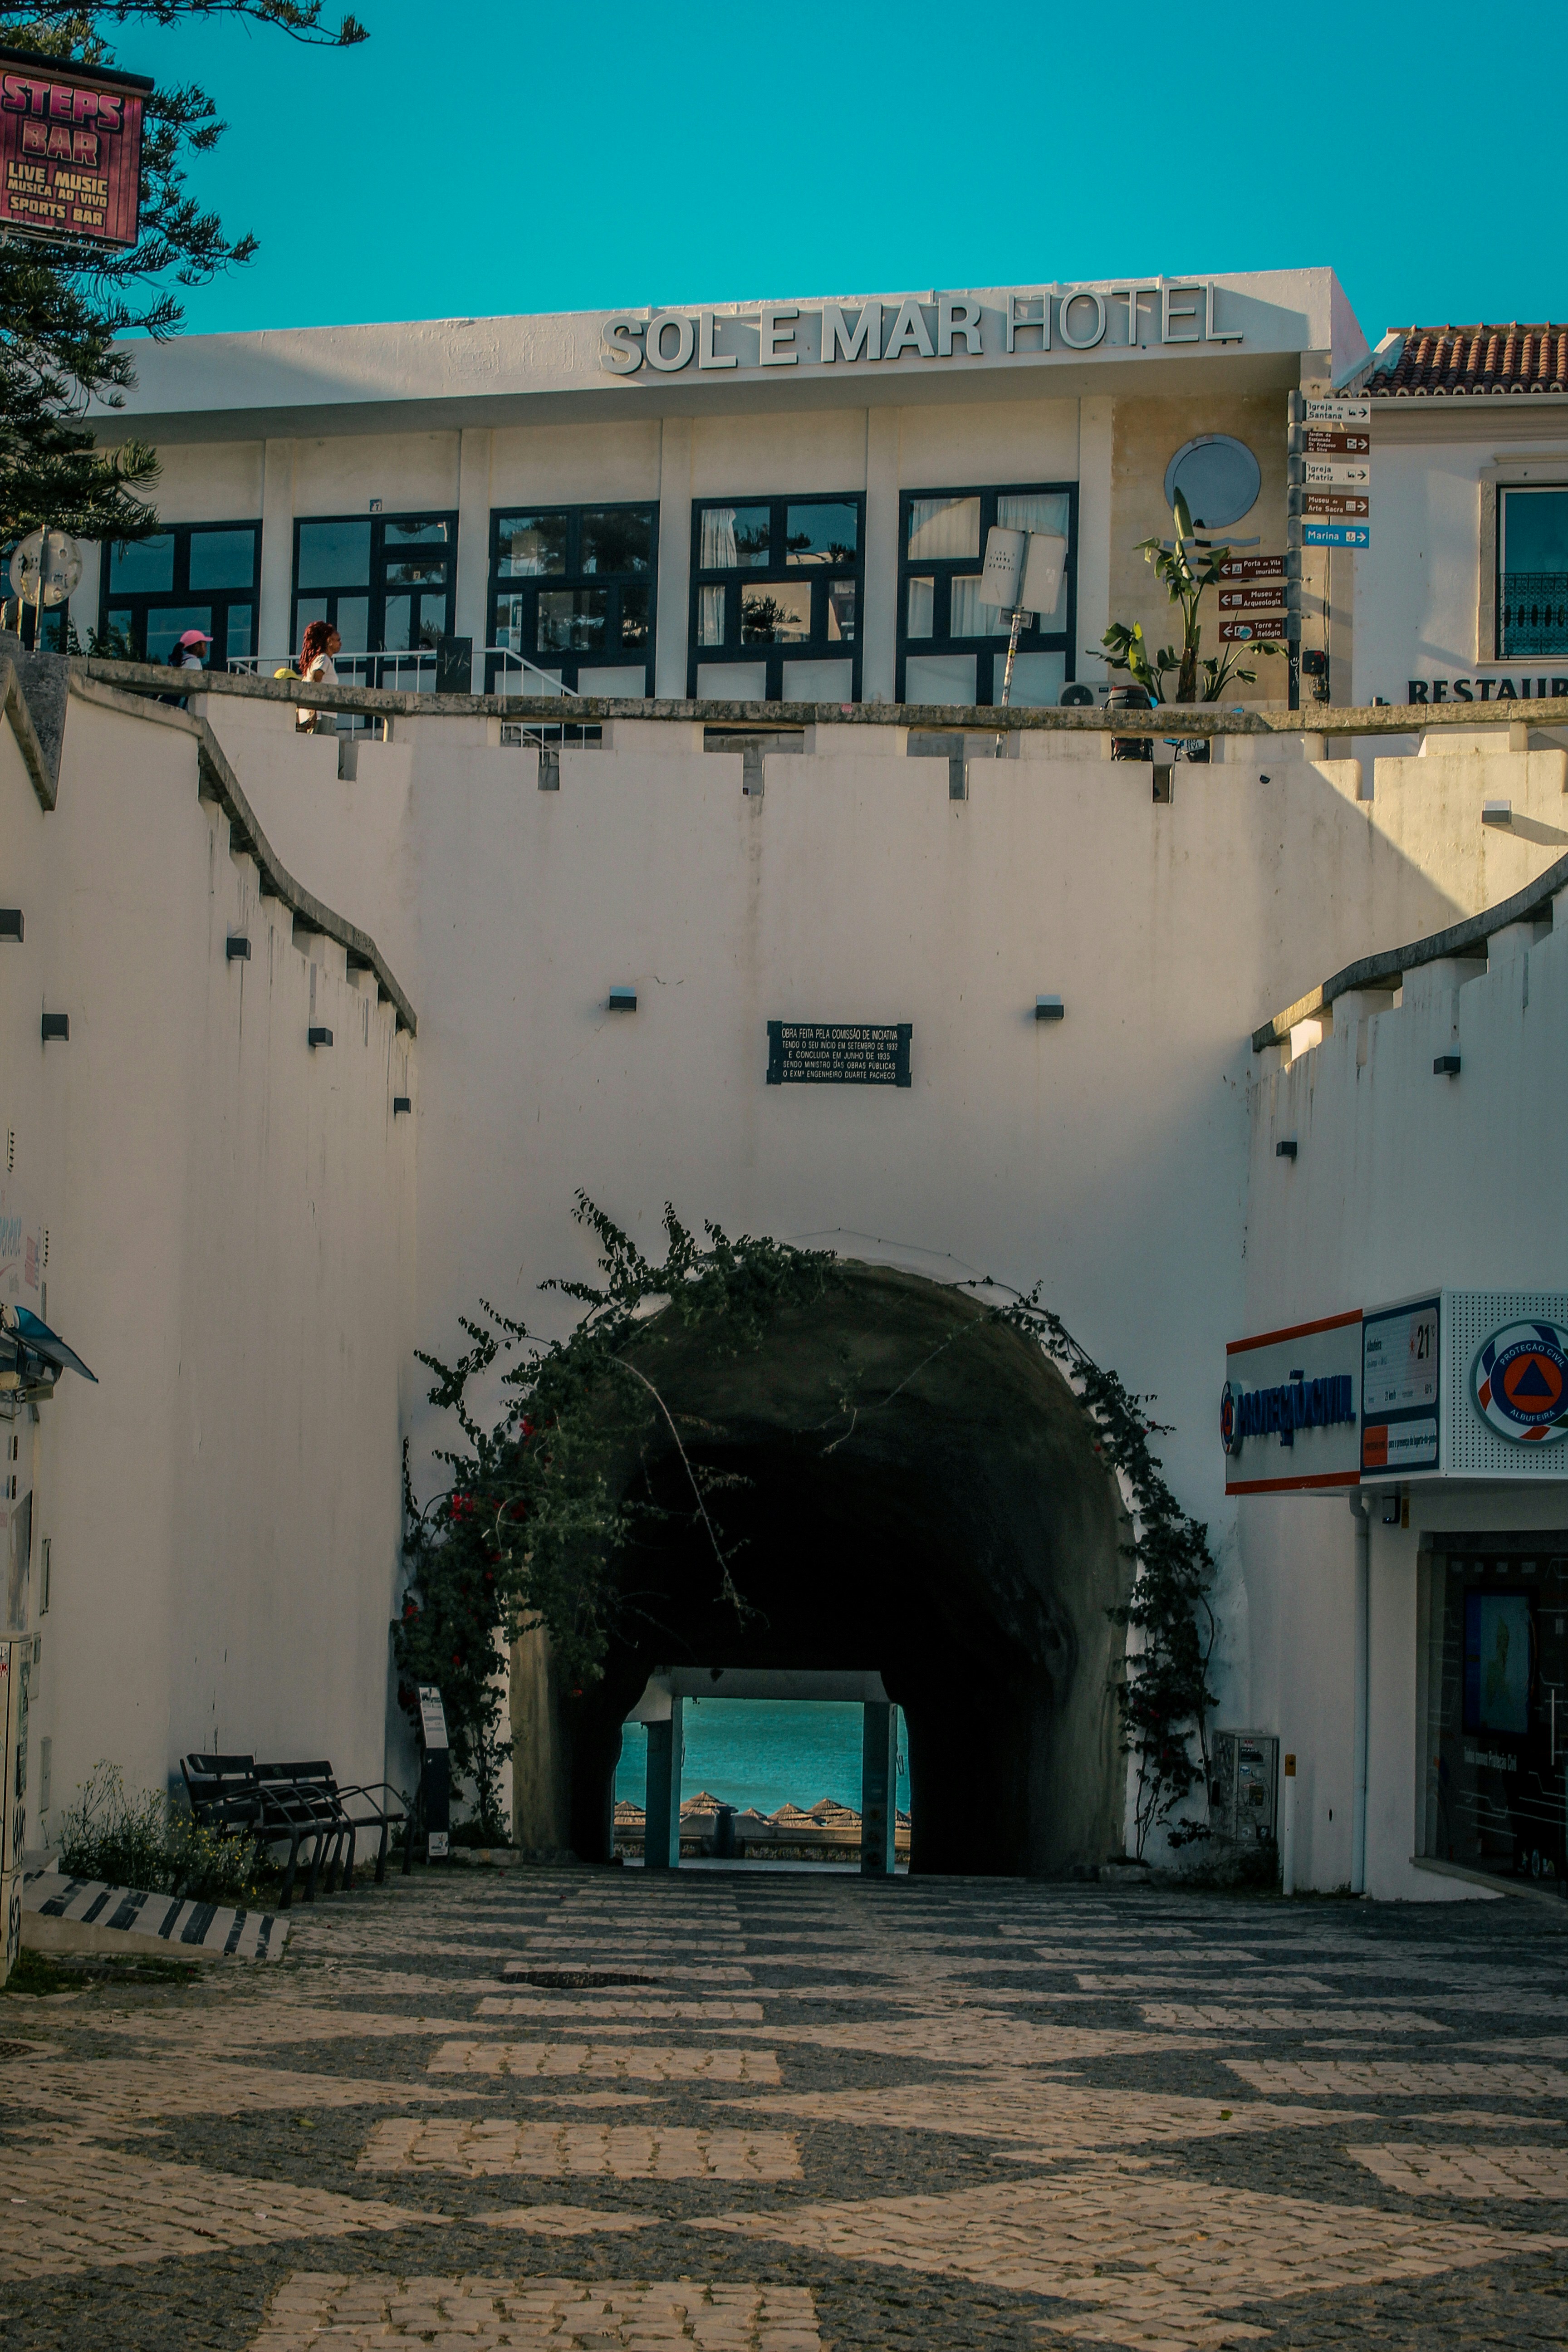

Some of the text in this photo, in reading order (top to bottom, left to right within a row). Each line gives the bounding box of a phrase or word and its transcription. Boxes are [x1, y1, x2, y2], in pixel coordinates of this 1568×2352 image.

[3, 75, 121, 130] STEPS
[23, 120, 98, 167] BAR
[9, 162, 108, 196] LIVE MUSIC
[8, 178, 108, 207] MUSICA AO VIVO
[10, 196, 103, 226] SPORTS BAR
[600, 280, 1244, 375] SOL E MAR HOTEL
[1309, 403, 1333, 412] Igreja
[1309, 411, 1342, 419] Santana
[1308, 464, 1332, 474] Igreja
[1308, 496, 1329, 504] Museu
[1308, 504, 1343, 513] Arte Sacra
[1308, 530, 1339, 540] Marina
[1243, 598, 1281, 607] Arqueologia
[1257, 629, 1281, 637] Relógio
[781, 1028, 898, 1040] OBRA FEITA PELA COMISSÃO DE INICIATIVA
[887, 1043, 898, 1051] 1932
[789, 1050, 792, 1058] E
[796, 1051, 830, 1059] CONCLUIDA
[833, 1051, 841, 1059] EM
[844, 1052, 864, 1060] JUNHO
[866, 1052, 874, 1060] DE
[868, 1061, 896, 1070] PÚBLICAS
[845, 1071, 867, 1079] DUARTE
[869, 1071, 896, 1079] PACHECO
[1417, 1324, 1429, 1359] 21
[1500, 1343, 1565, 1368] PROTEÇÃO CIVIL
[1237, 1369, 1356, 1447] PROTEÇÃO CIVIL
[1509, 1409, 1555, 1421] ALBUFEIRA
